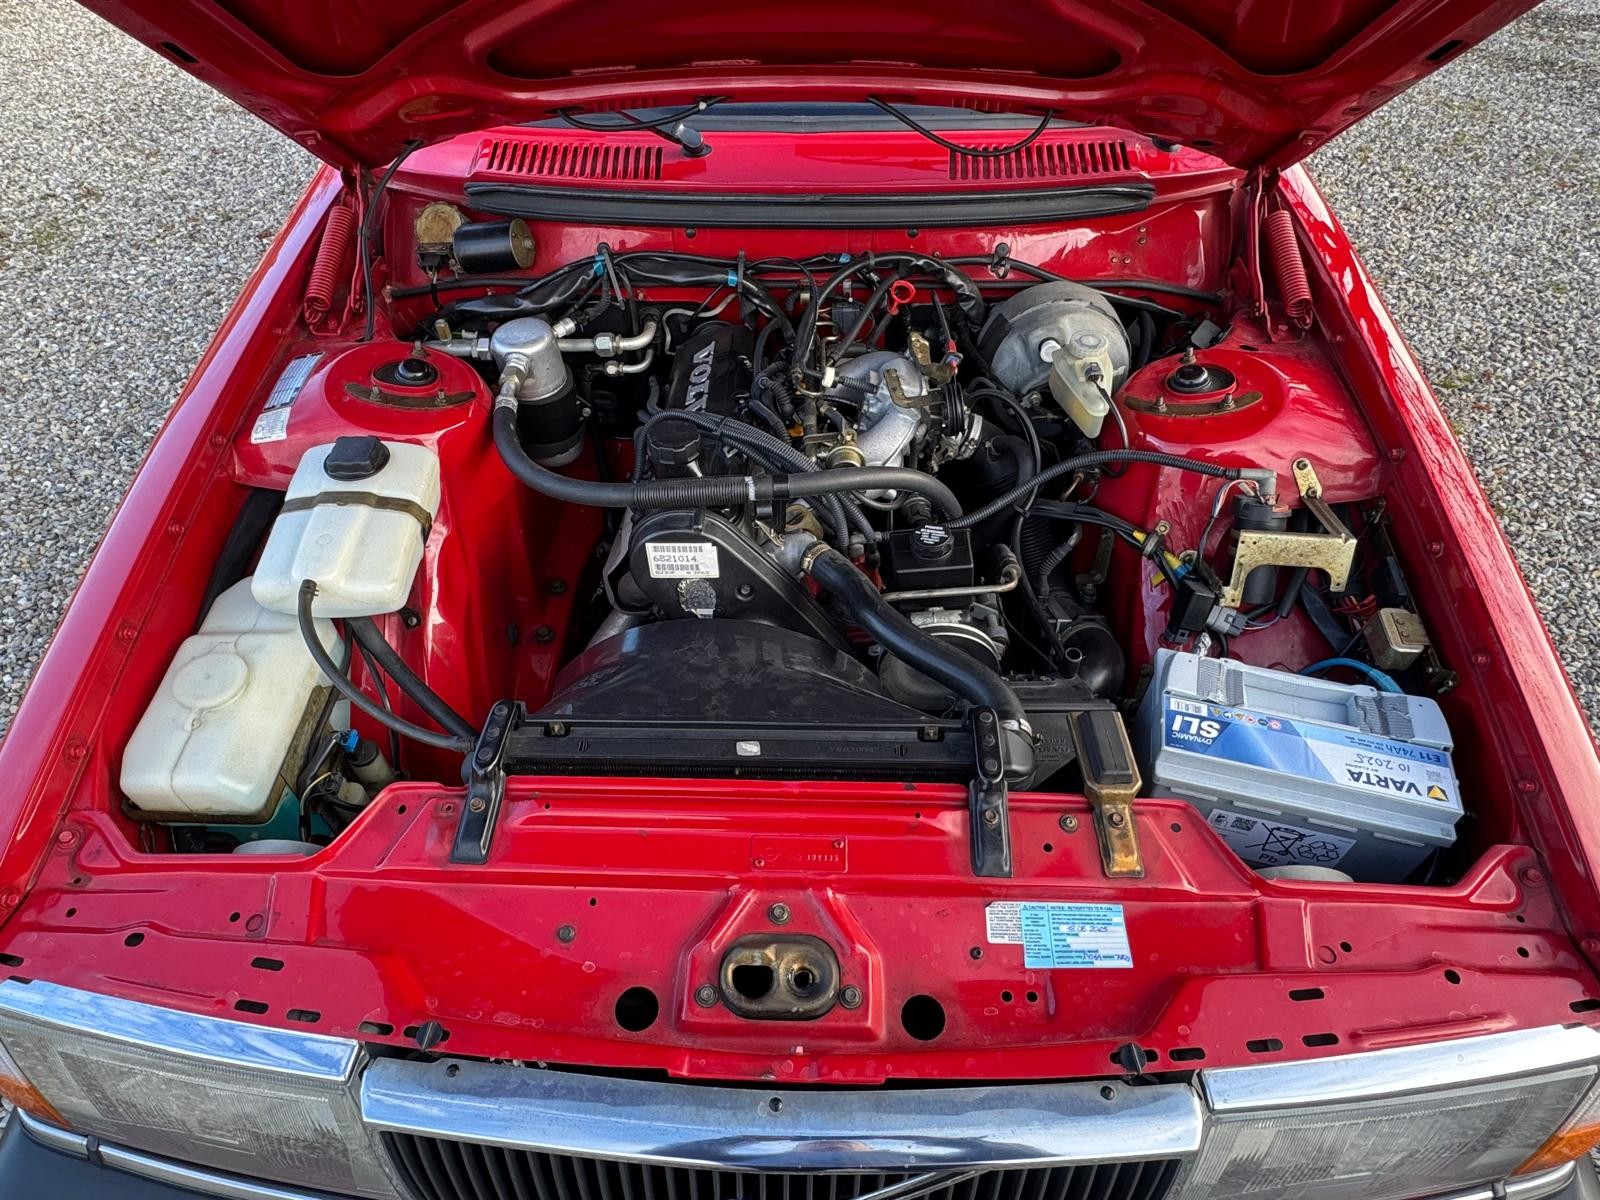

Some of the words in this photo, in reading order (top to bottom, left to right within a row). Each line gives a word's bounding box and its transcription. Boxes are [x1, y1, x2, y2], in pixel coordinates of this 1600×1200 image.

[684, 340, 716, 413] VOLV
[652, 554, 698, 563] 6821014
[1171, 714, 1221, 738] SLI
[1171, 731, 1213, 745] DYNAMIC
[1385, 743, 1417, 758] 74Ah
[1419, 751, 1441, 763] E11
[1346, 768, 1423, 797] VARTA
[1260, 853, 1278, 864] Pb
